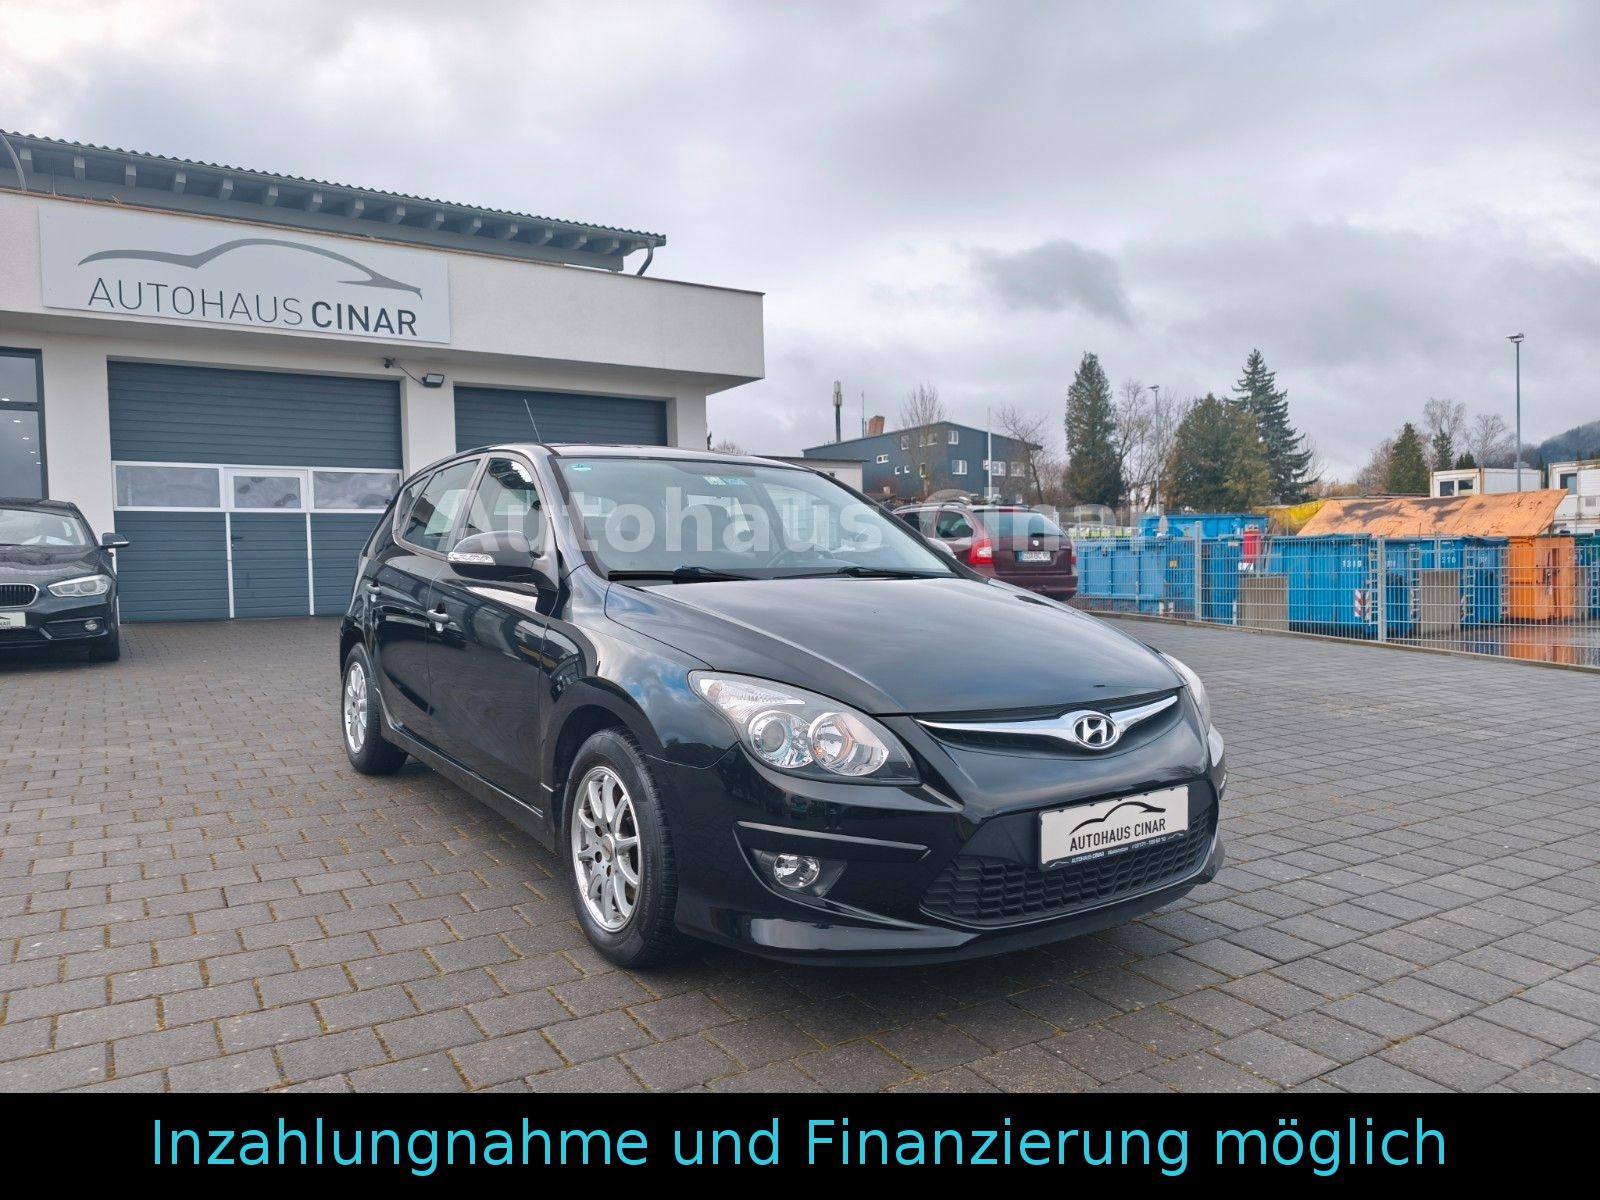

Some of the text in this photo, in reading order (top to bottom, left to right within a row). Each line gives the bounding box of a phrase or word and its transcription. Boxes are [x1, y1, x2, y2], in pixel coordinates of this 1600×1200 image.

[88, 276, 418, 337] AUTOHAUS CINAR
[1070, 825, 1131, 852] AUTOHAUS
[1134, 817, 1167, 837] CINAR
